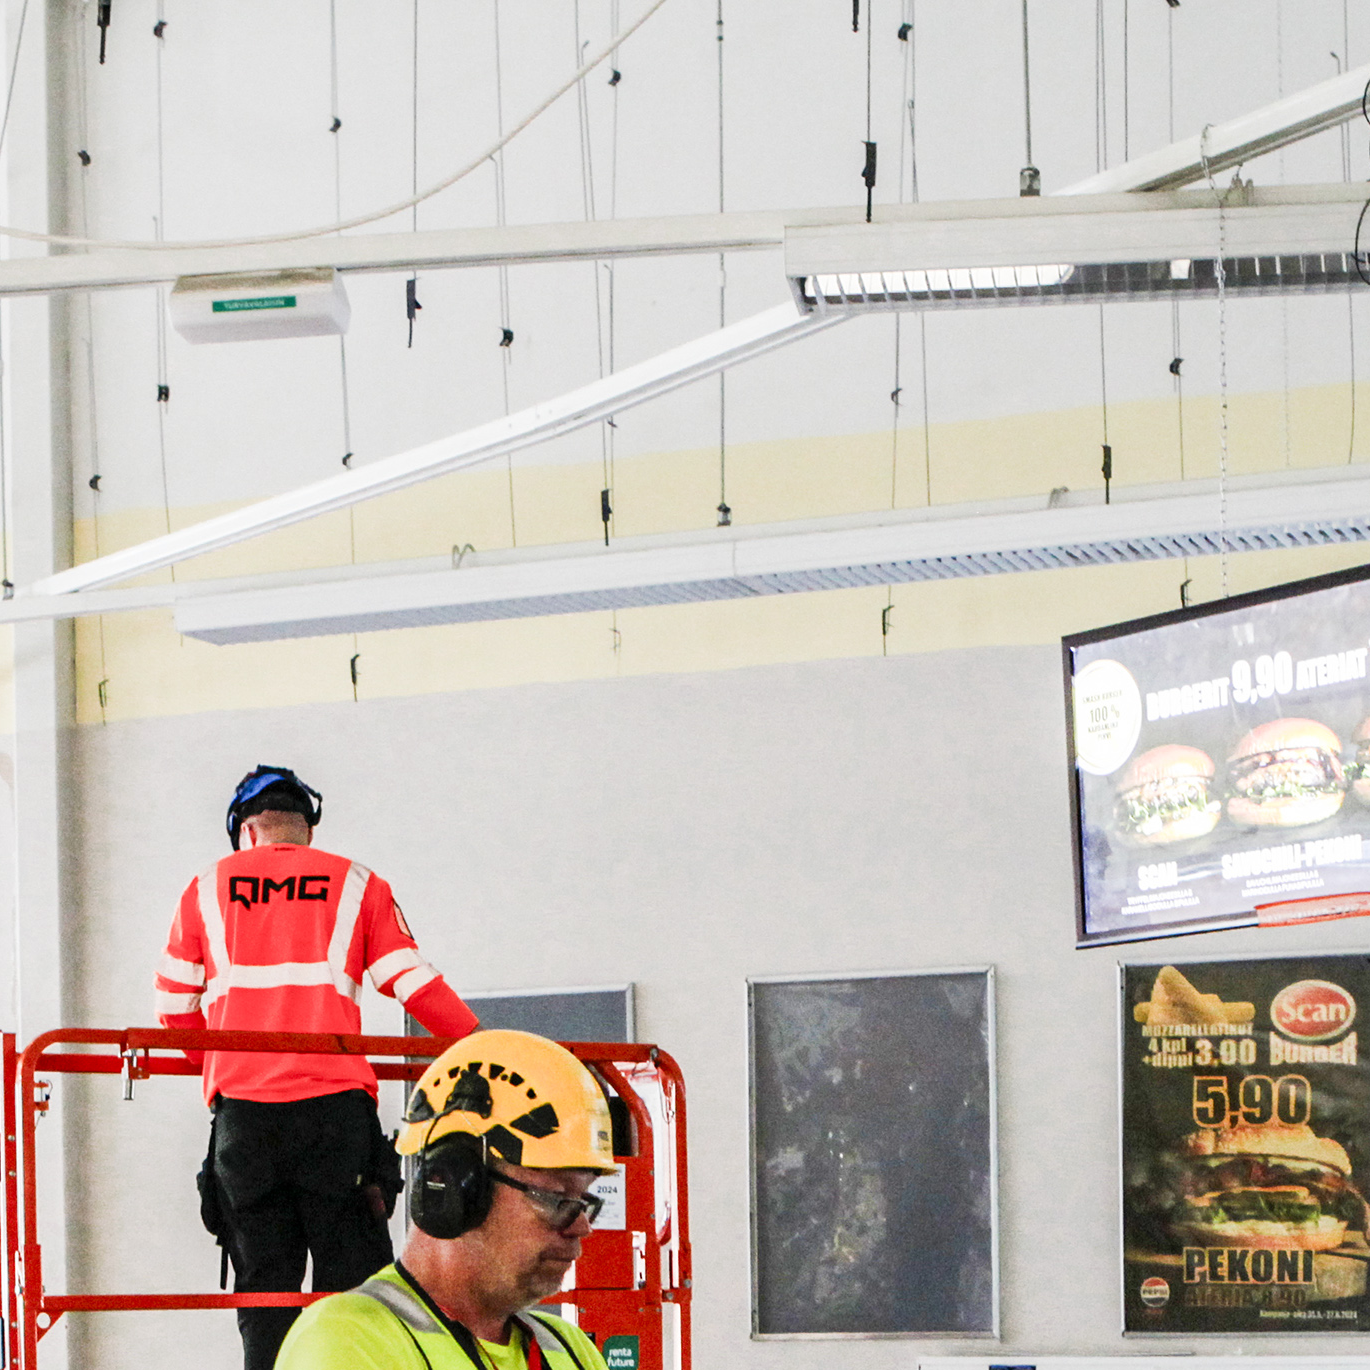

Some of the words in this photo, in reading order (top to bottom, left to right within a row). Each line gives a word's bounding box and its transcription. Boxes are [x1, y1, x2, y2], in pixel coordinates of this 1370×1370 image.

[1147, 676, 1230, 721] BURGERIT
[1231, 651, 1293, 705] 9,90
[1296, 647, 1368, 691] ATERIAT
[1090, 705, 1108, 723] 100
[229, 876, 330, 911] QMG
[1281, 998, 1346, 1024] Scan
[1148, 1038, 1159, 1053] 4
[1195, 1038, 1257, 1067] 3,90
[1270, 1031, 1357, 1066] BURGER
[1193, 1074, 1311, 1130] 5,90
[597, 1185, 618, 1194] 2024
[1183, 1247, 1315, 1285] PEKONI
[607, 1357, 634, 1368] future
[609, 1347, 632, 1357] renta
